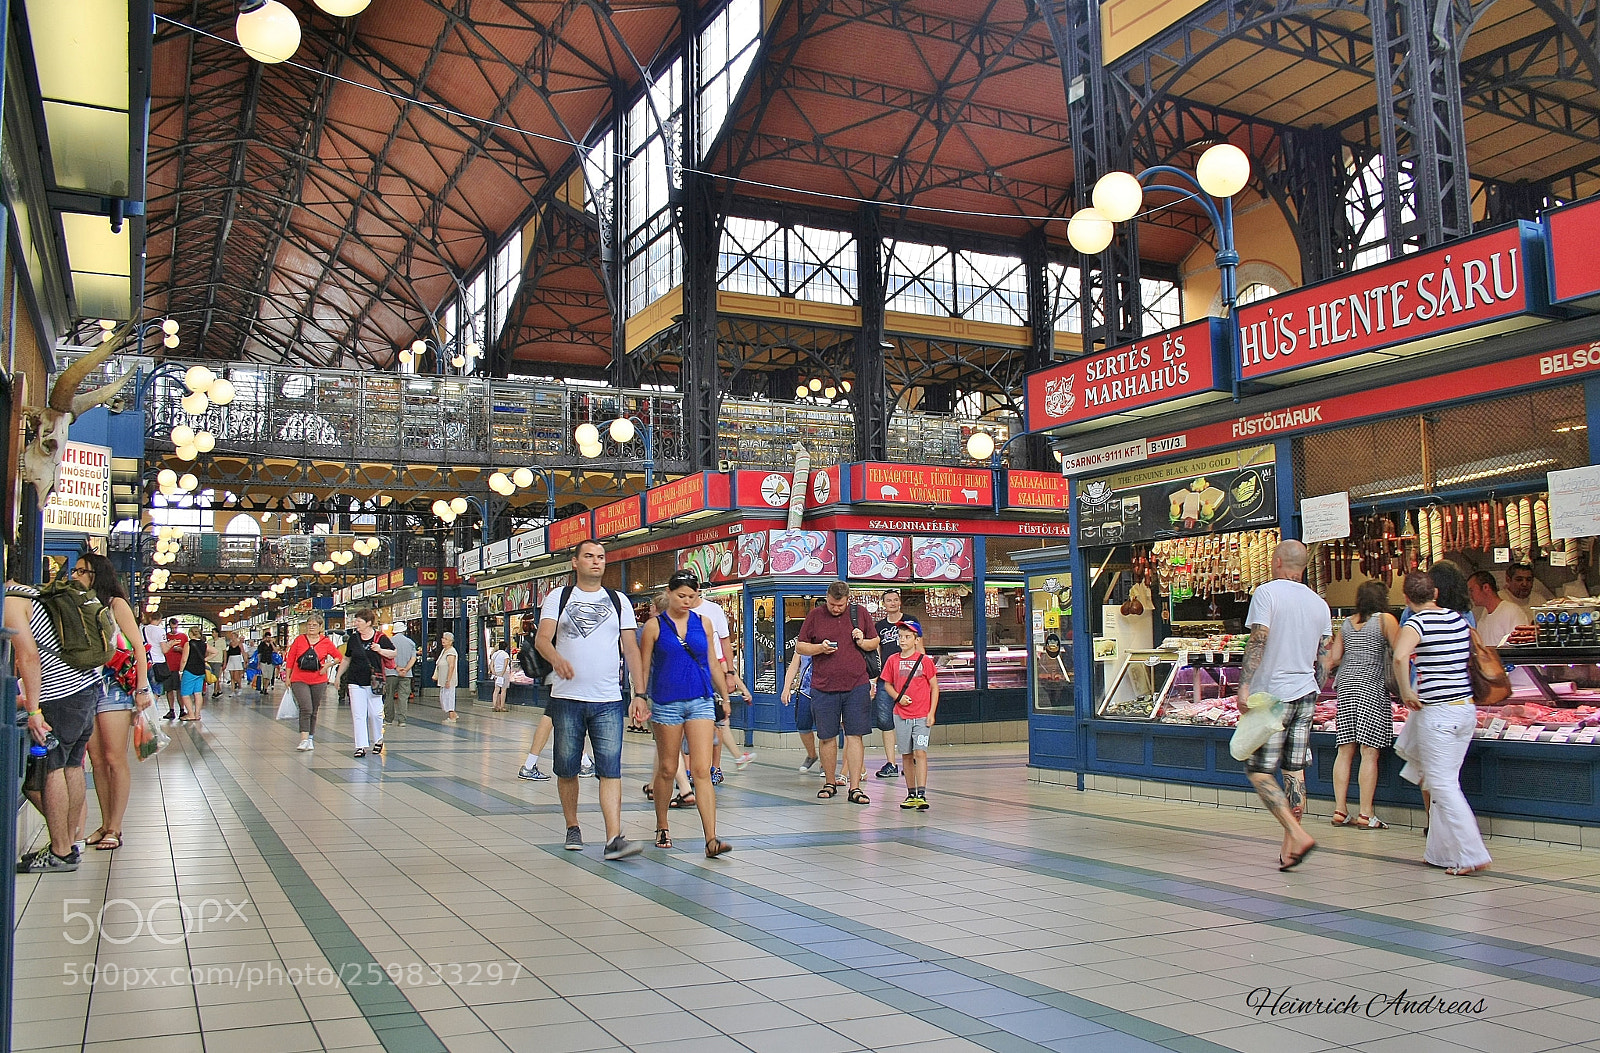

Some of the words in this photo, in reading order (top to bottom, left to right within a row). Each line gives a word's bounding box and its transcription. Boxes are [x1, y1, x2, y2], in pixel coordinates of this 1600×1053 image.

[1086, 344, 1151, 382] SERTÉS
[1162, 334, 1186, 361] ÉS
[1084, 360, 1190, 408] MARHAHÚS
[1231, 405, 1323, 438] FÜSTÖLTÁRUK
[79, 450, 104, 467] BOLT
[1065, 449, 1123, 470] CSARNOK-9111
[1124, 446, 1144, 458] KFT.
[1117, 476, 1132, 485] THE
[1133, 470, 1164, 482] GENUINE
[1166, 466, 1189, 477] BLACK
[1191, 462, 1206, 471] AND
[1209, 458, 1231, 468] GOLD
[68, 498, 100, 510] BONTVA
